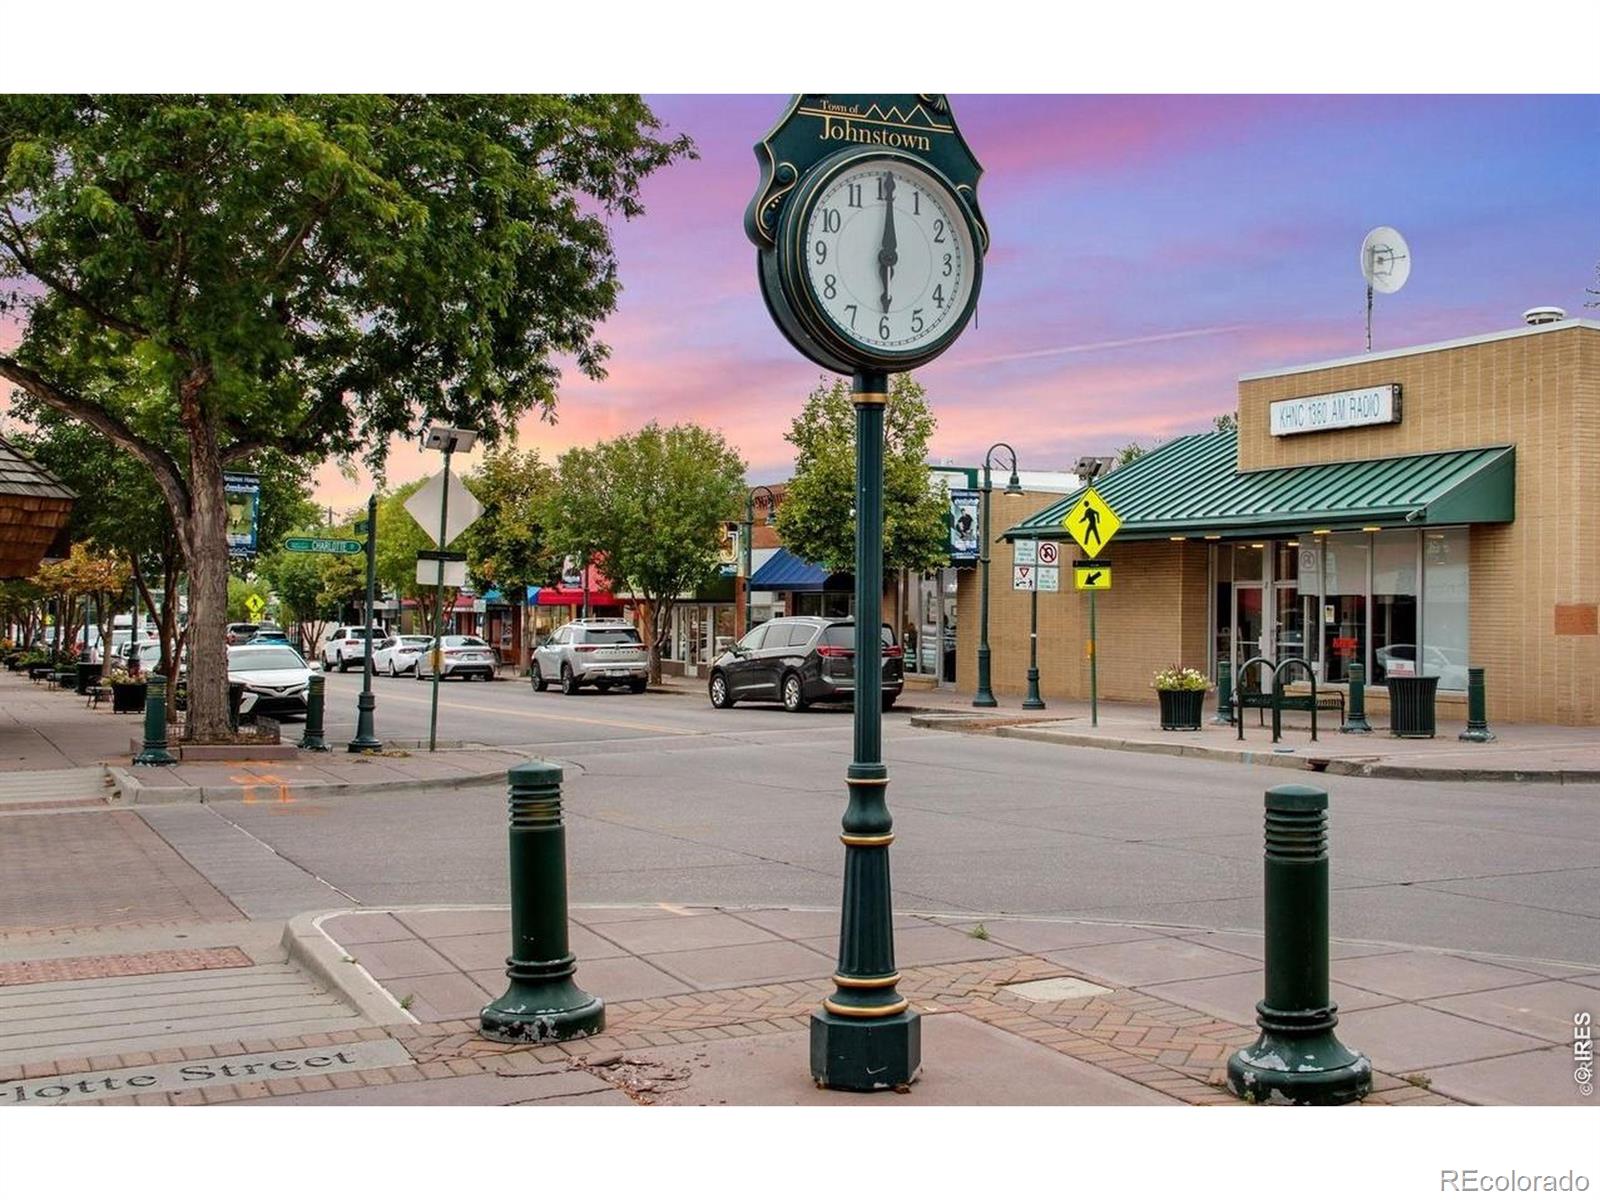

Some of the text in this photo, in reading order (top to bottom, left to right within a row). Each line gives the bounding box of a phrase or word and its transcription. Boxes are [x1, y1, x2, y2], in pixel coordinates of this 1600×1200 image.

[820, 99, 860, 114] Town of
[819, 115, 931, 151] Johnstown
[848, 183, 863, 208] 11
[913, 190, 921, 216] 1
[822, 208, 841, 234] 10
[933, 219, 946, 243] 2
[815, 240, 828, 265] 9
[942, 253, 953, 277] 3
[823, 274, 837, 300] 8
[932, 283, 945, 309] 4
[844, 304, 858, 332] 7
[879, 316, 891, 340] 6
[911, 308, 924, 333] 5
[1280, 403, 1304, 428] KHNC
[1331, 397, 1346, 422] AM
[1349, 392, 1380, 421] RADIO
[312, 540, 346, 553] CHARLOTTE
[0, 1052, 356, 1102] lotte Street
